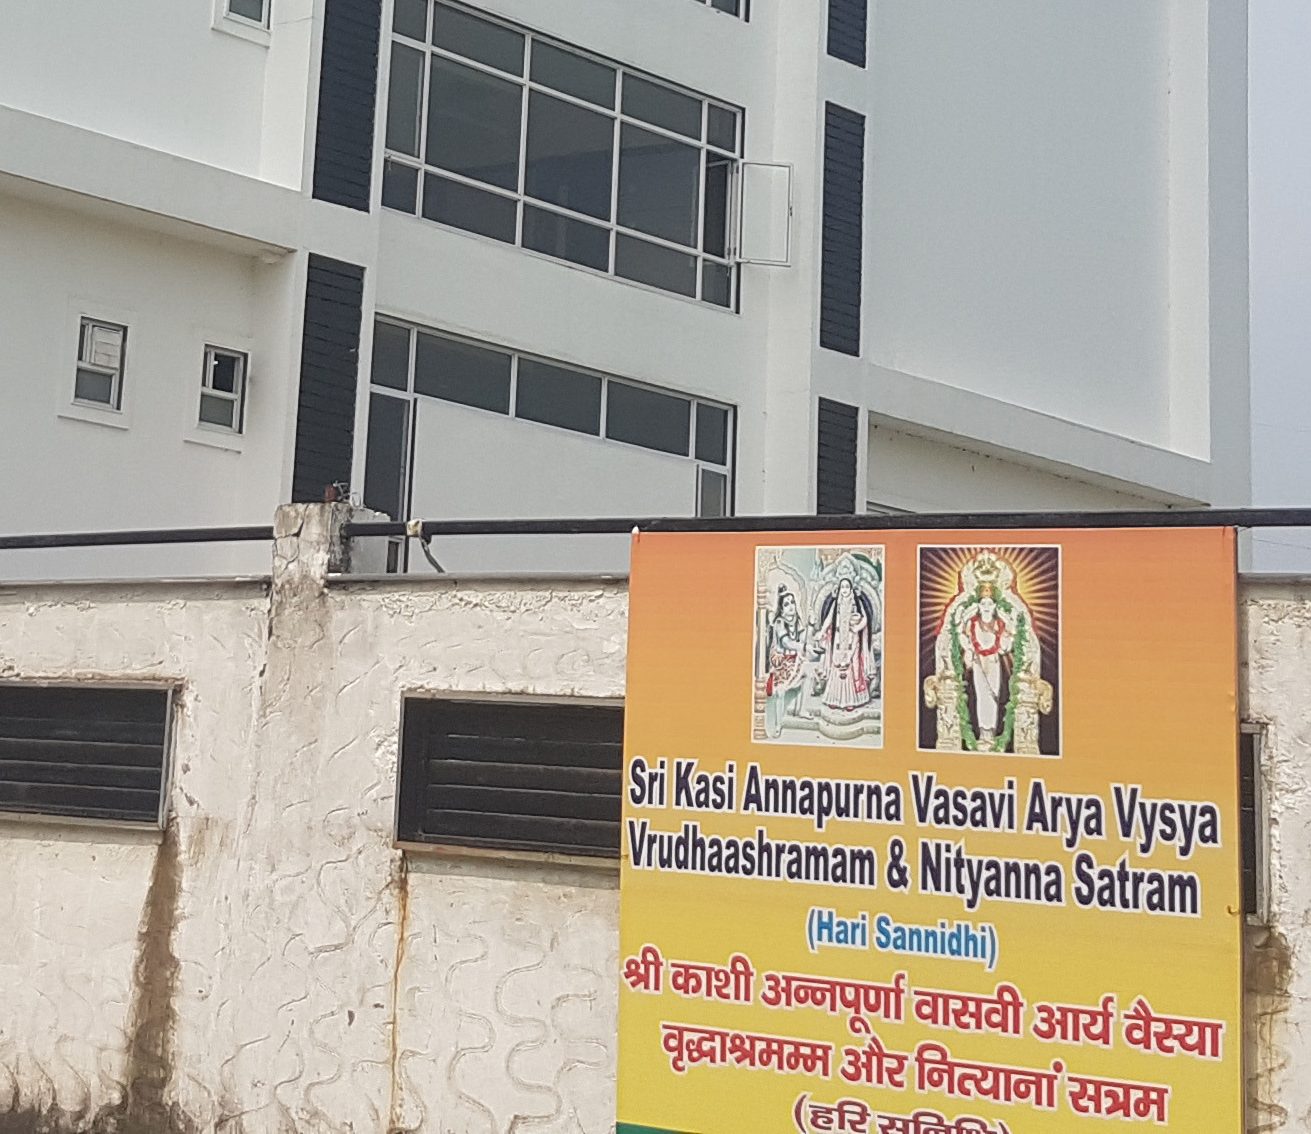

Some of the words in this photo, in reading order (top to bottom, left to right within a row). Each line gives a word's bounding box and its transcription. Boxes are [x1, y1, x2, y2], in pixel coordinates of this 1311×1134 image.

[629, 757, 665, 806] Sri
[674, 760, 735, 811] Kasi
[741, 764, 902, 830] Annapurna
[910, 773, 1015, 831] Vasavi
[1024, 780, 1104, 850] Arya
[1112, 785, 1219, 858] Vysya
[628, 820, 876, 887] Vrudhaashramam
[886, 838, 910, 890] &
[920, 840, 1064, 910] Nityanna
[1073, 852, 1199, 915] Satram
[807, 911, 867, 950] (Hari
[876, 914, 998, 967] Sannidhi)
[624, 946, 663, 991] श्री
[670, 955, 755, 1002] काशी
[761, 971, 906, 1034] अन्नपूर्णा
[913, 984, 1023, 1035] वासवी
[1032, 996, 1115, 1045] आर्य
[840, 1036, 908, 1088] और
[1067, 1075, 1169, 1123] सत्रम
